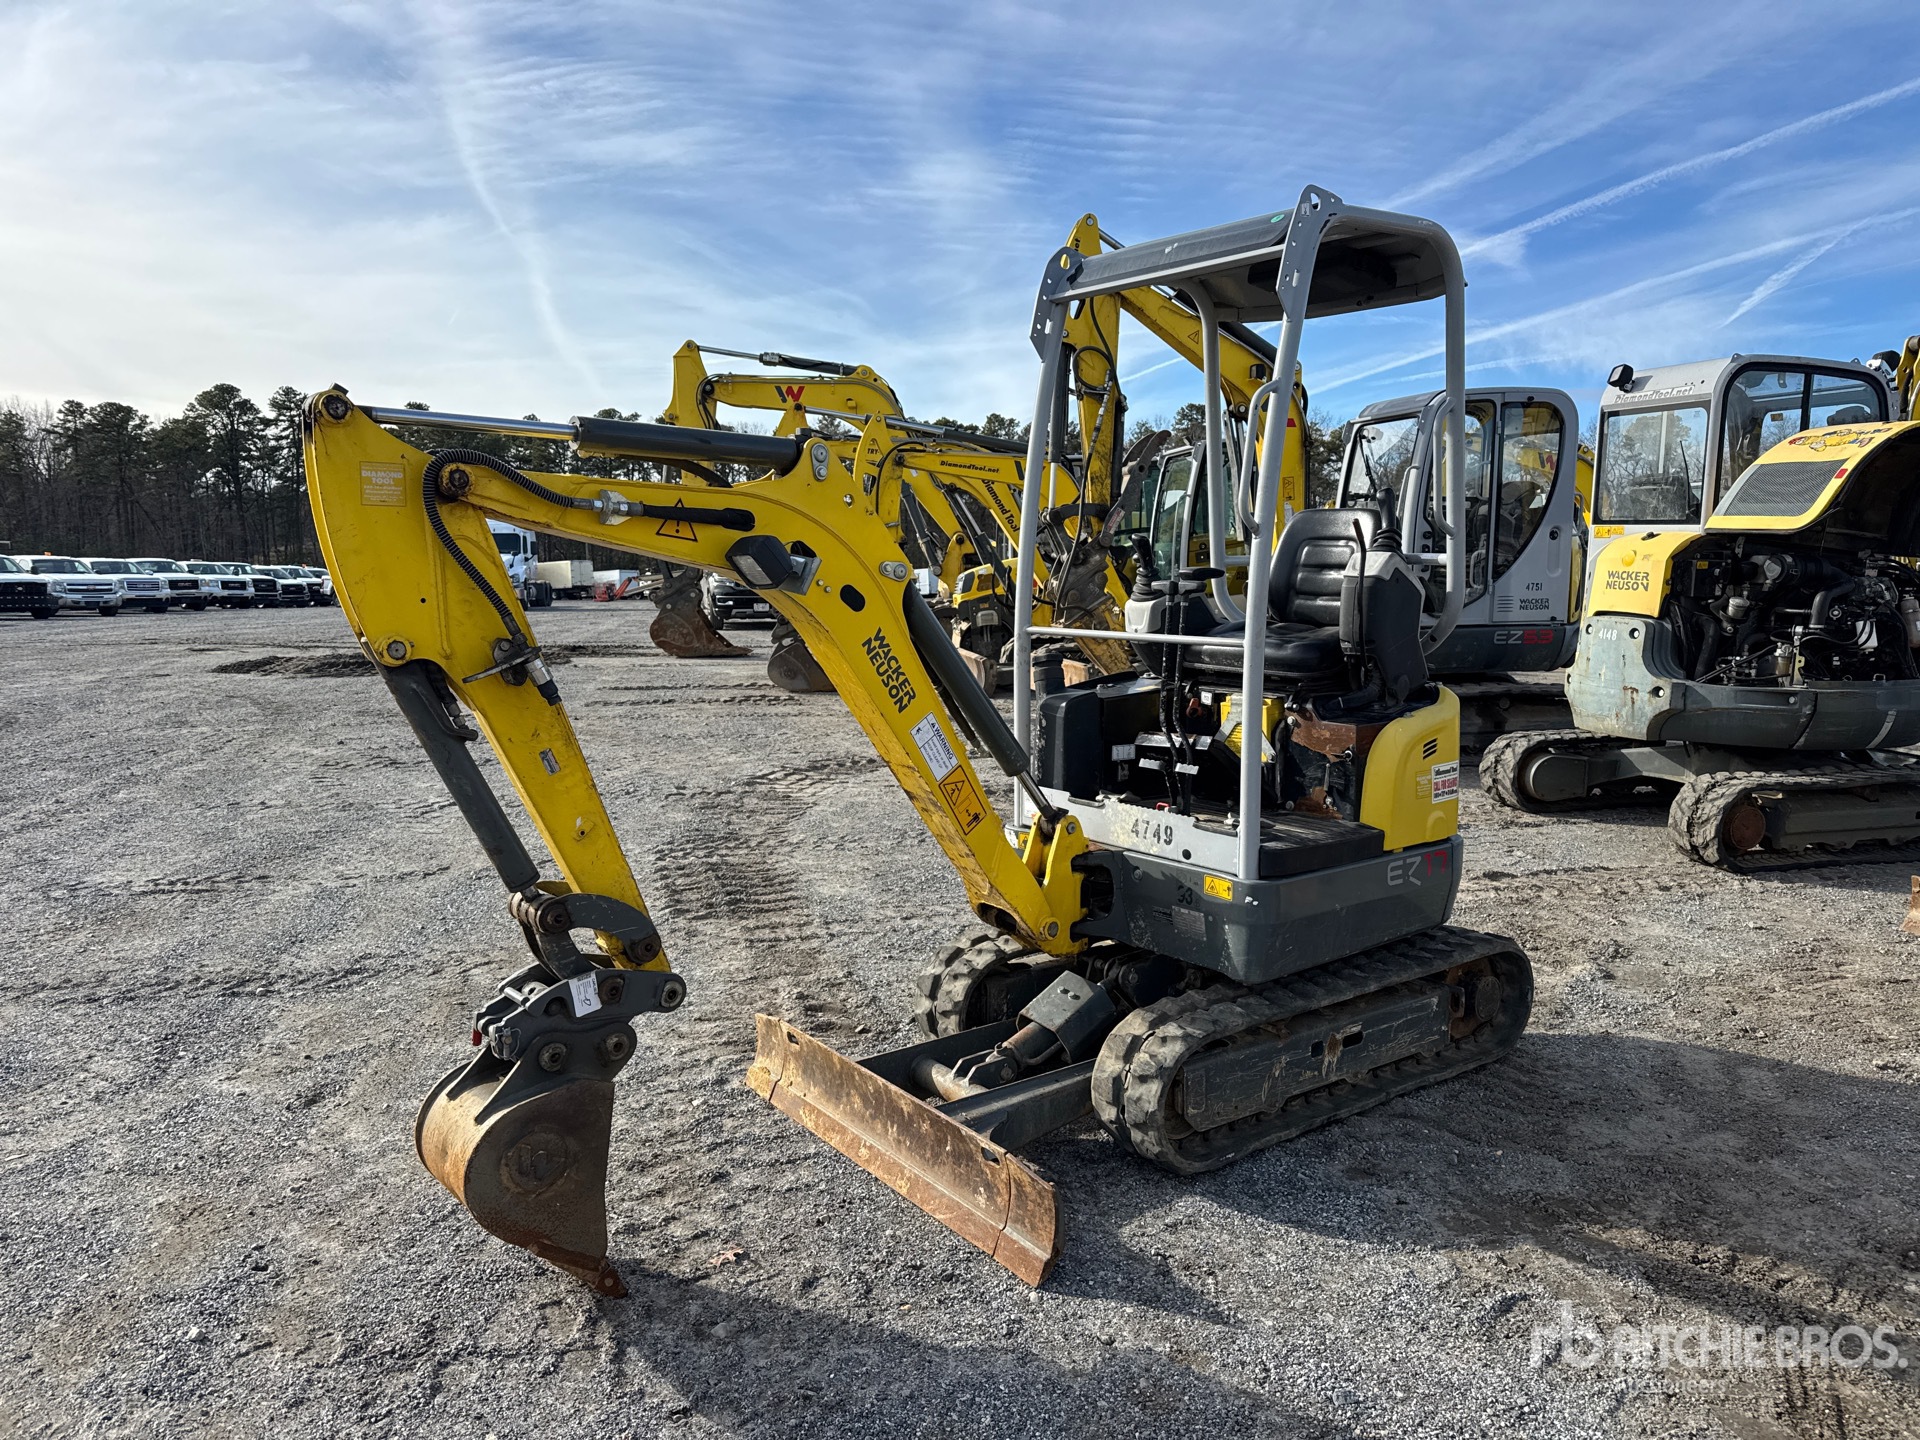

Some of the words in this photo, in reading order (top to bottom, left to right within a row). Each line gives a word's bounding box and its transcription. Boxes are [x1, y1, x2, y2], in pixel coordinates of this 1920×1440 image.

[1614, 387, 1694, 403] DiamondTool.net
[362, 470, 403, 478] DIAMOND
[940, 460, 1000, 473] DiamondTool.net
[1608, 570, 1650, 582] WACKER
[1606, 580, 1649, 592] NEUSON
[1494, 629, 1554, 644] EZ53
[1598, 628, 1618, 640] 4148
[873, 626, 916, 705] WACKER
[862, 637, 908, 714] NEUSON
[933, 726, 954, 759] WARNING
[1131, 818, 1172, 846] 4749
